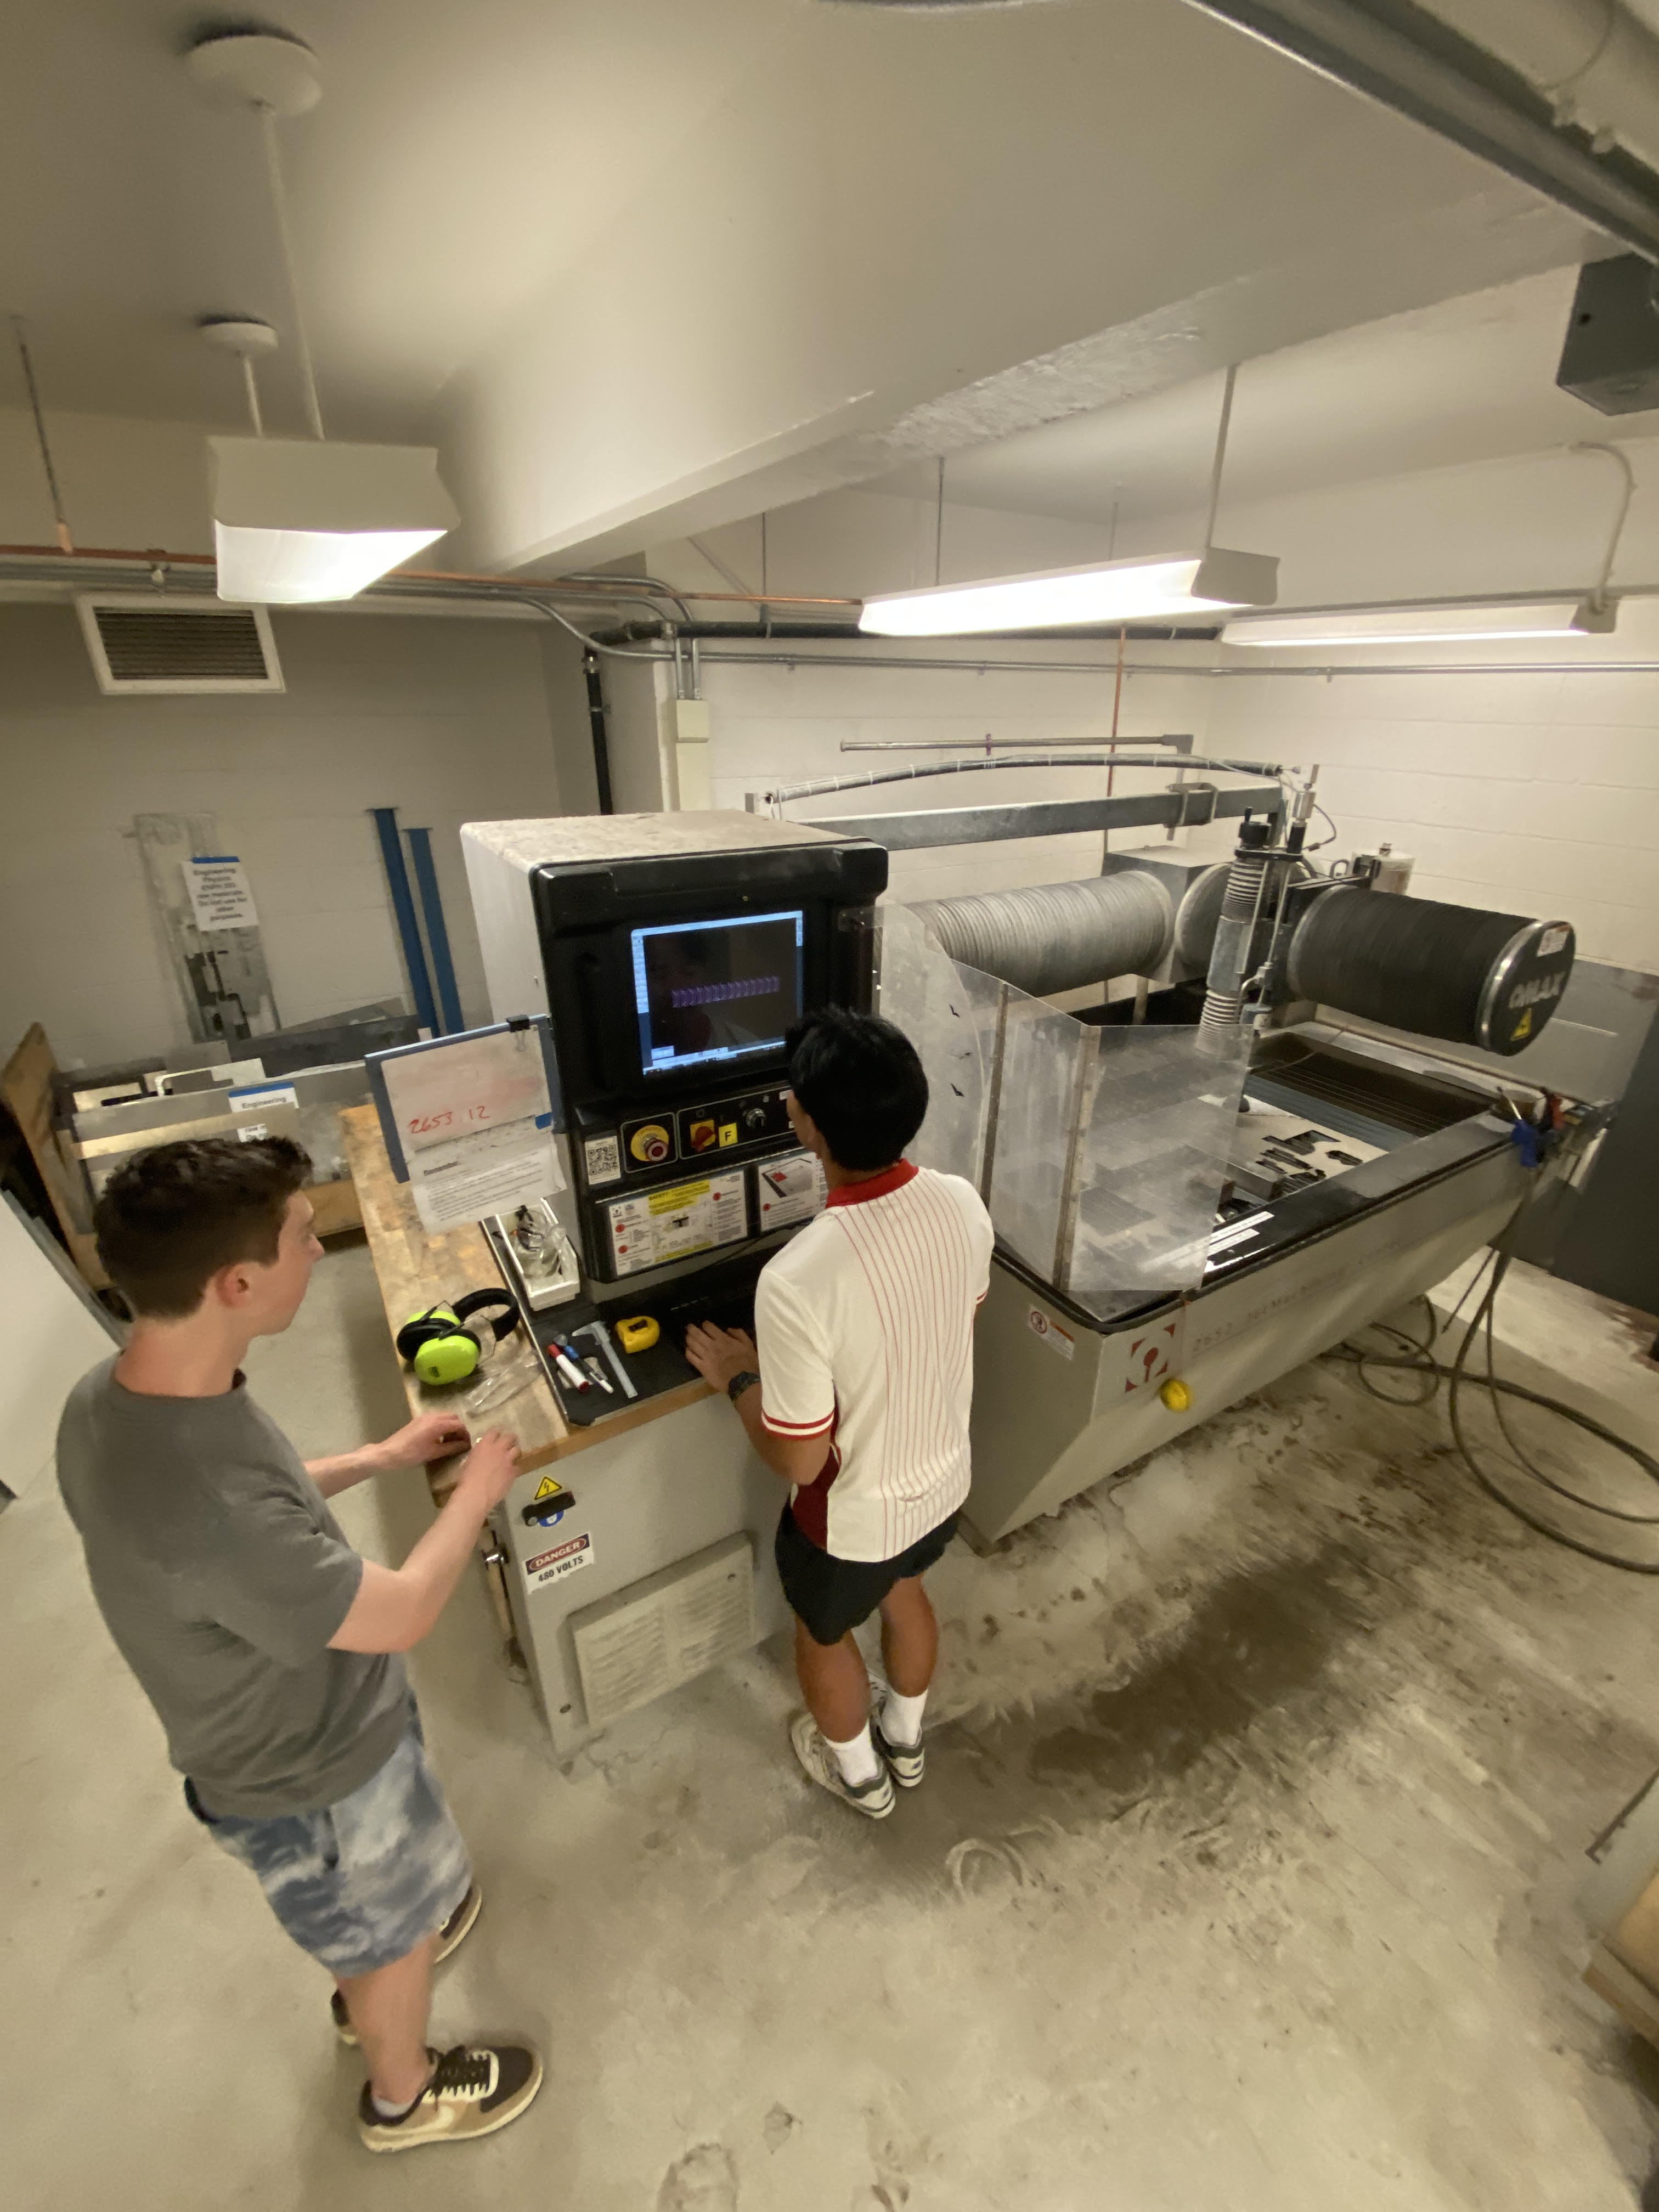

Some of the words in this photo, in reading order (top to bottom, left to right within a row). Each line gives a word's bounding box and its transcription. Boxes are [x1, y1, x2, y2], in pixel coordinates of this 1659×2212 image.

[242, 1097, 286, 1109] Engineering
[725, 1131, 732, 1141] F
[535, 1541, 580, 1567] DANGER
[538, 1570, 555, 1582] 480
[556, 1555, 584, 1574] VOLTS
